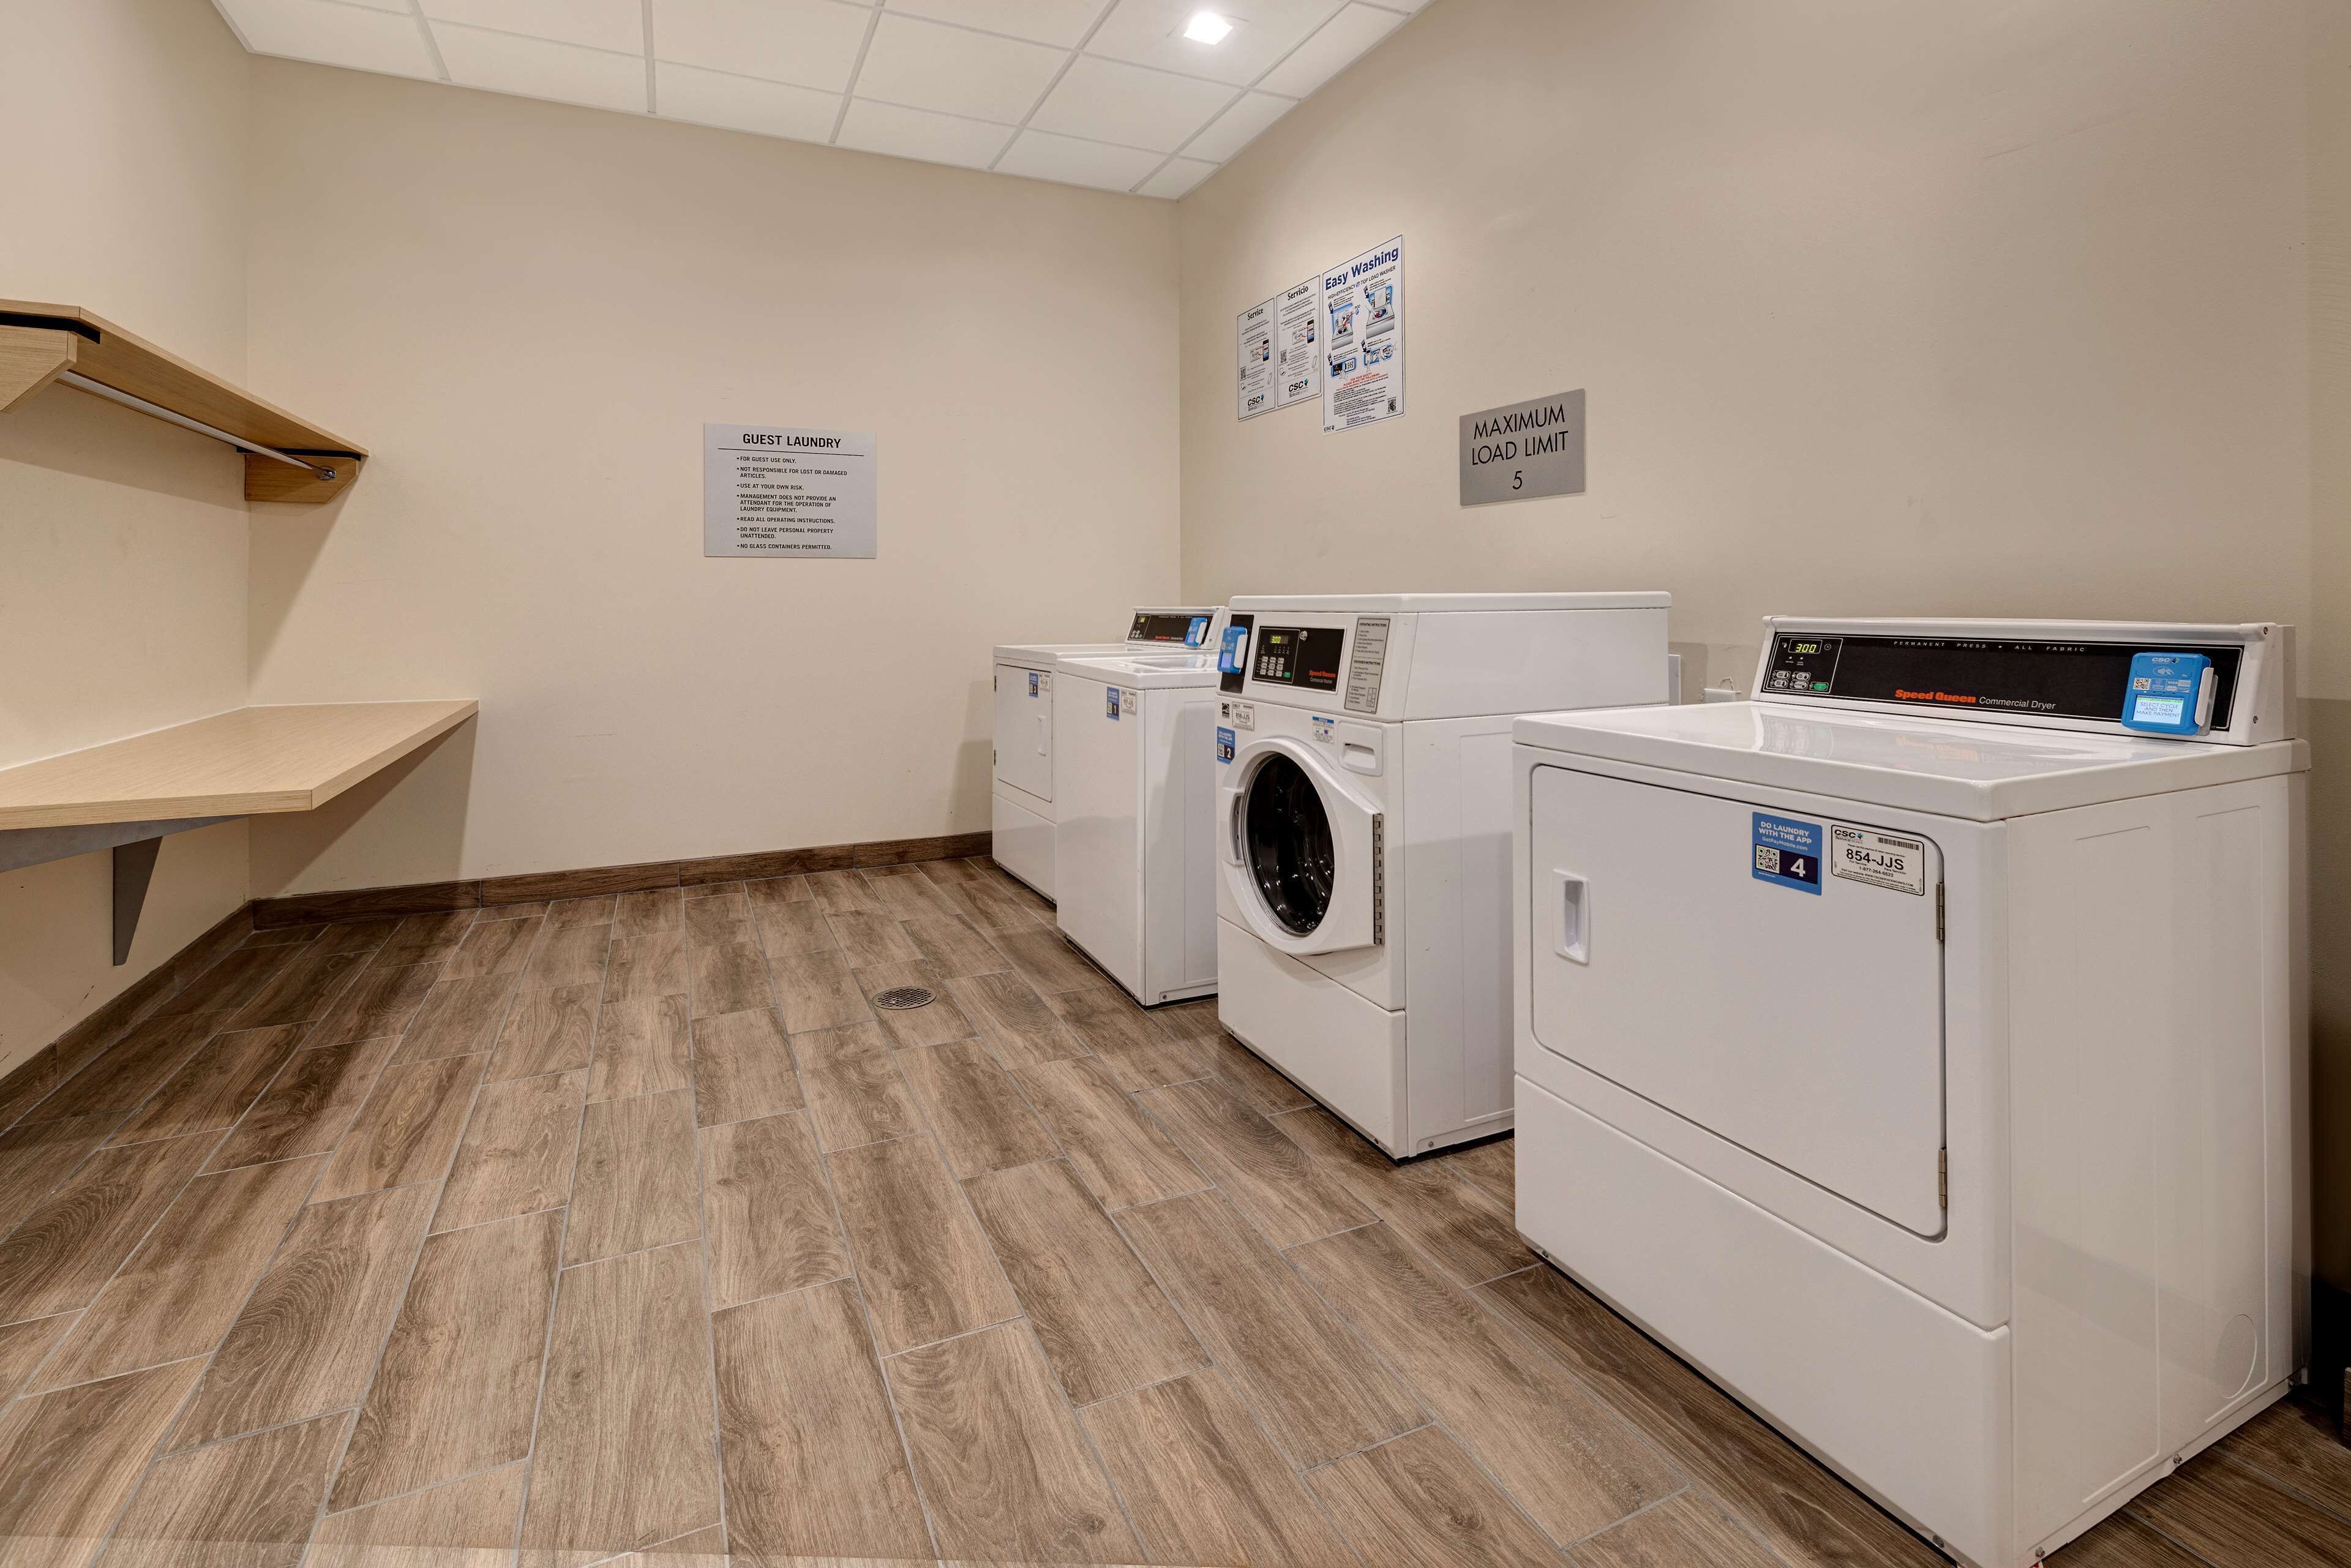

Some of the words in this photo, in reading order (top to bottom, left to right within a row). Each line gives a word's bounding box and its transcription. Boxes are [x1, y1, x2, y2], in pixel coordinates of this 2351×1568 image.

[1325, 271, 1348, 291] Easy
[1351, 247, 1398, 278] Washing
[1327, 283, 1355, 300] HIGH-EFFICIENCY
[1368, 273, 1379, 282] LOAD
[1379, 265, 1396, 277] WASHER
[1288, 285, 1308, 301] Servicio
[1247, 308, 1263, 320] Service
[1289, 381, 1303, 392] CSC
[1248, 396, 1261, 406] CSC
[1474, 403, 1565, 440] MAXIMUM
[743, 433, 782, 445] GUEST
[787, 436, 841, 448] LAUNDRY
[1472, 441, 1517, 465] LOAD
[1524, 430, 1569, 456] LIMIT
[1512, 470, 1523, 490] 5
[1796, 643, 1817, 653] 300
[1895, 689, 1934, 699] Speed
[1935, 692, 1976, 703] Queen
[1979, 696, 2029, 707] Commercial
[2031, 700, 2056, 710] Dryer
[1114, 705, 1117, 714] 1
[1226, 748, 1231, 759] 2
[1758, 828, 1778, 837] WITH
[1774, 824, 1809, 837] LAUNDRY
[1834, 829, 1856, 838] CSC
[1762, 836, 1808, 850] GetPayMobile.com
[1846, 848, 1904, 870] 854-JJS
[1790, 858, 1805, 877] 4
